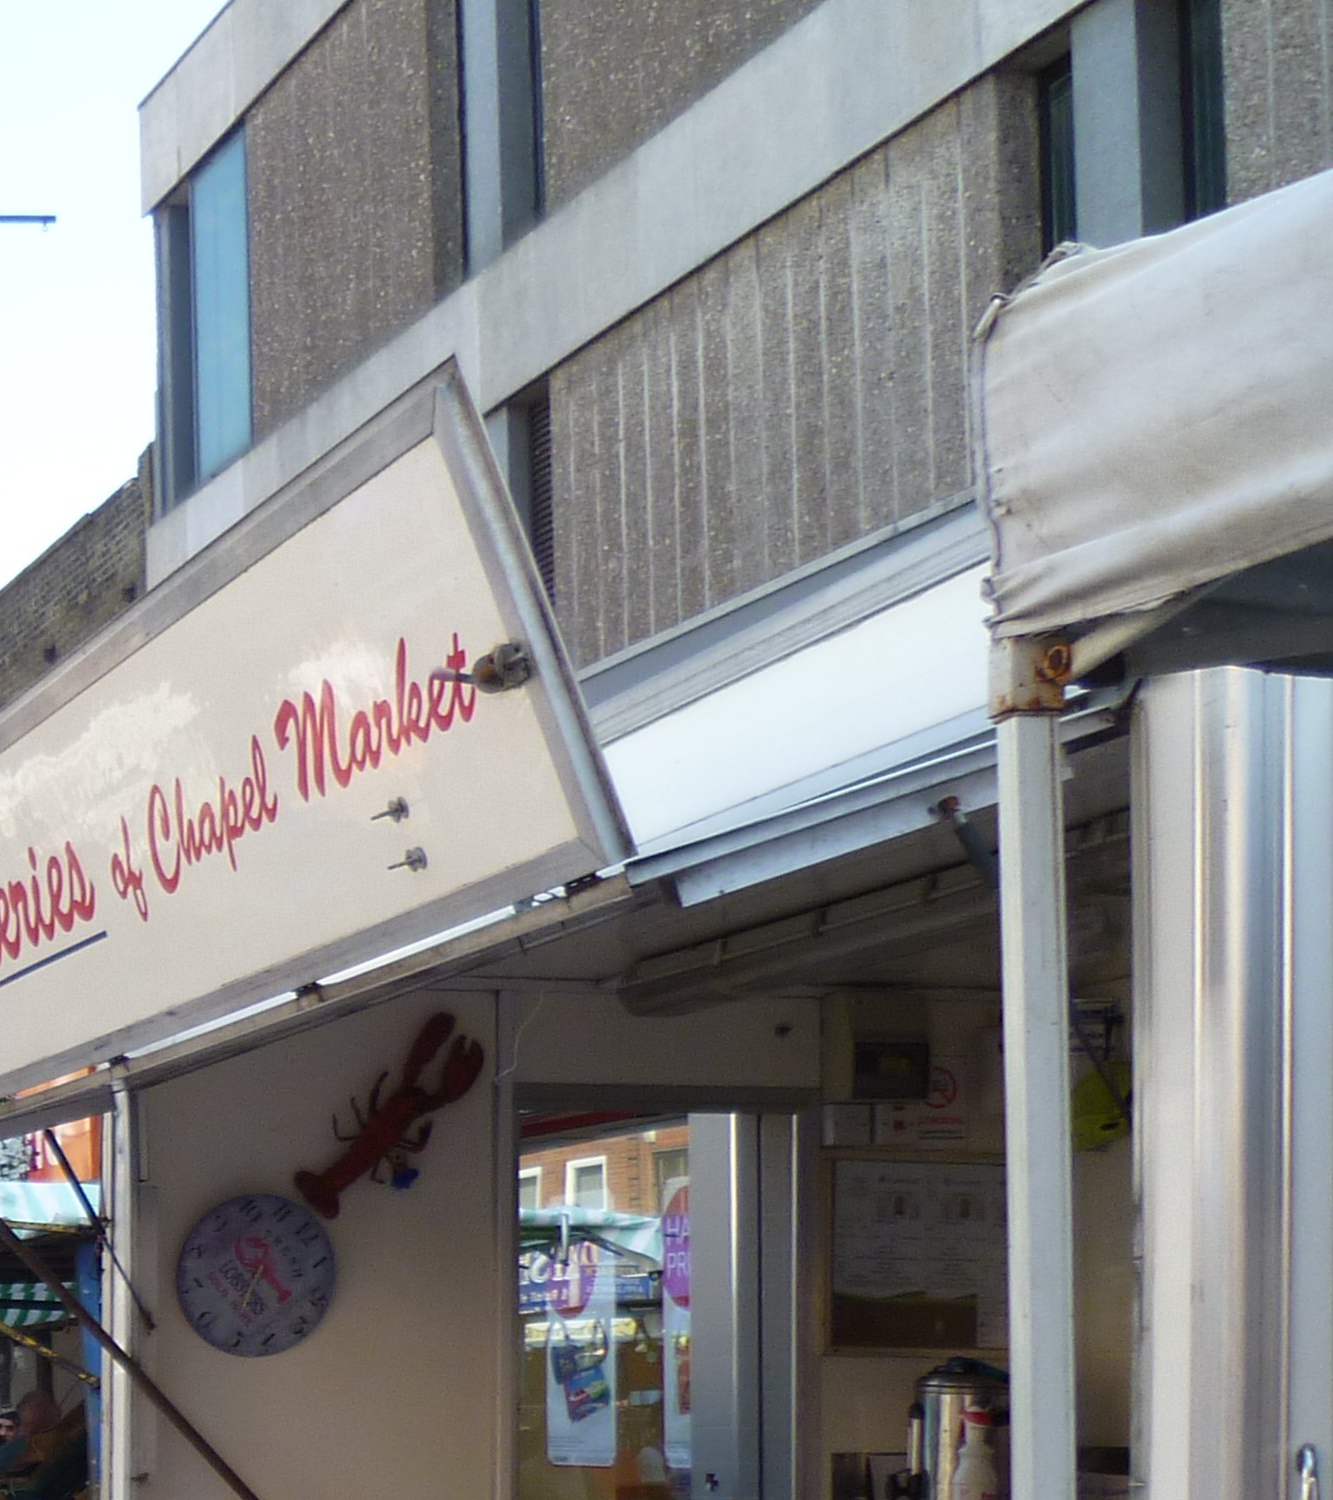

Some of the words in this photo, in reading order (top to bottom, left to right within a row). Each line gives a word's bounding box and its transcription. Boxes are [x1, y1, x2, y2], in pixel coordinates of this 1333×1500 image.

[111, 816, 149, 922] of
[148, 735, 278, 894] Chapel
[274, 632, 476, 802] Market
